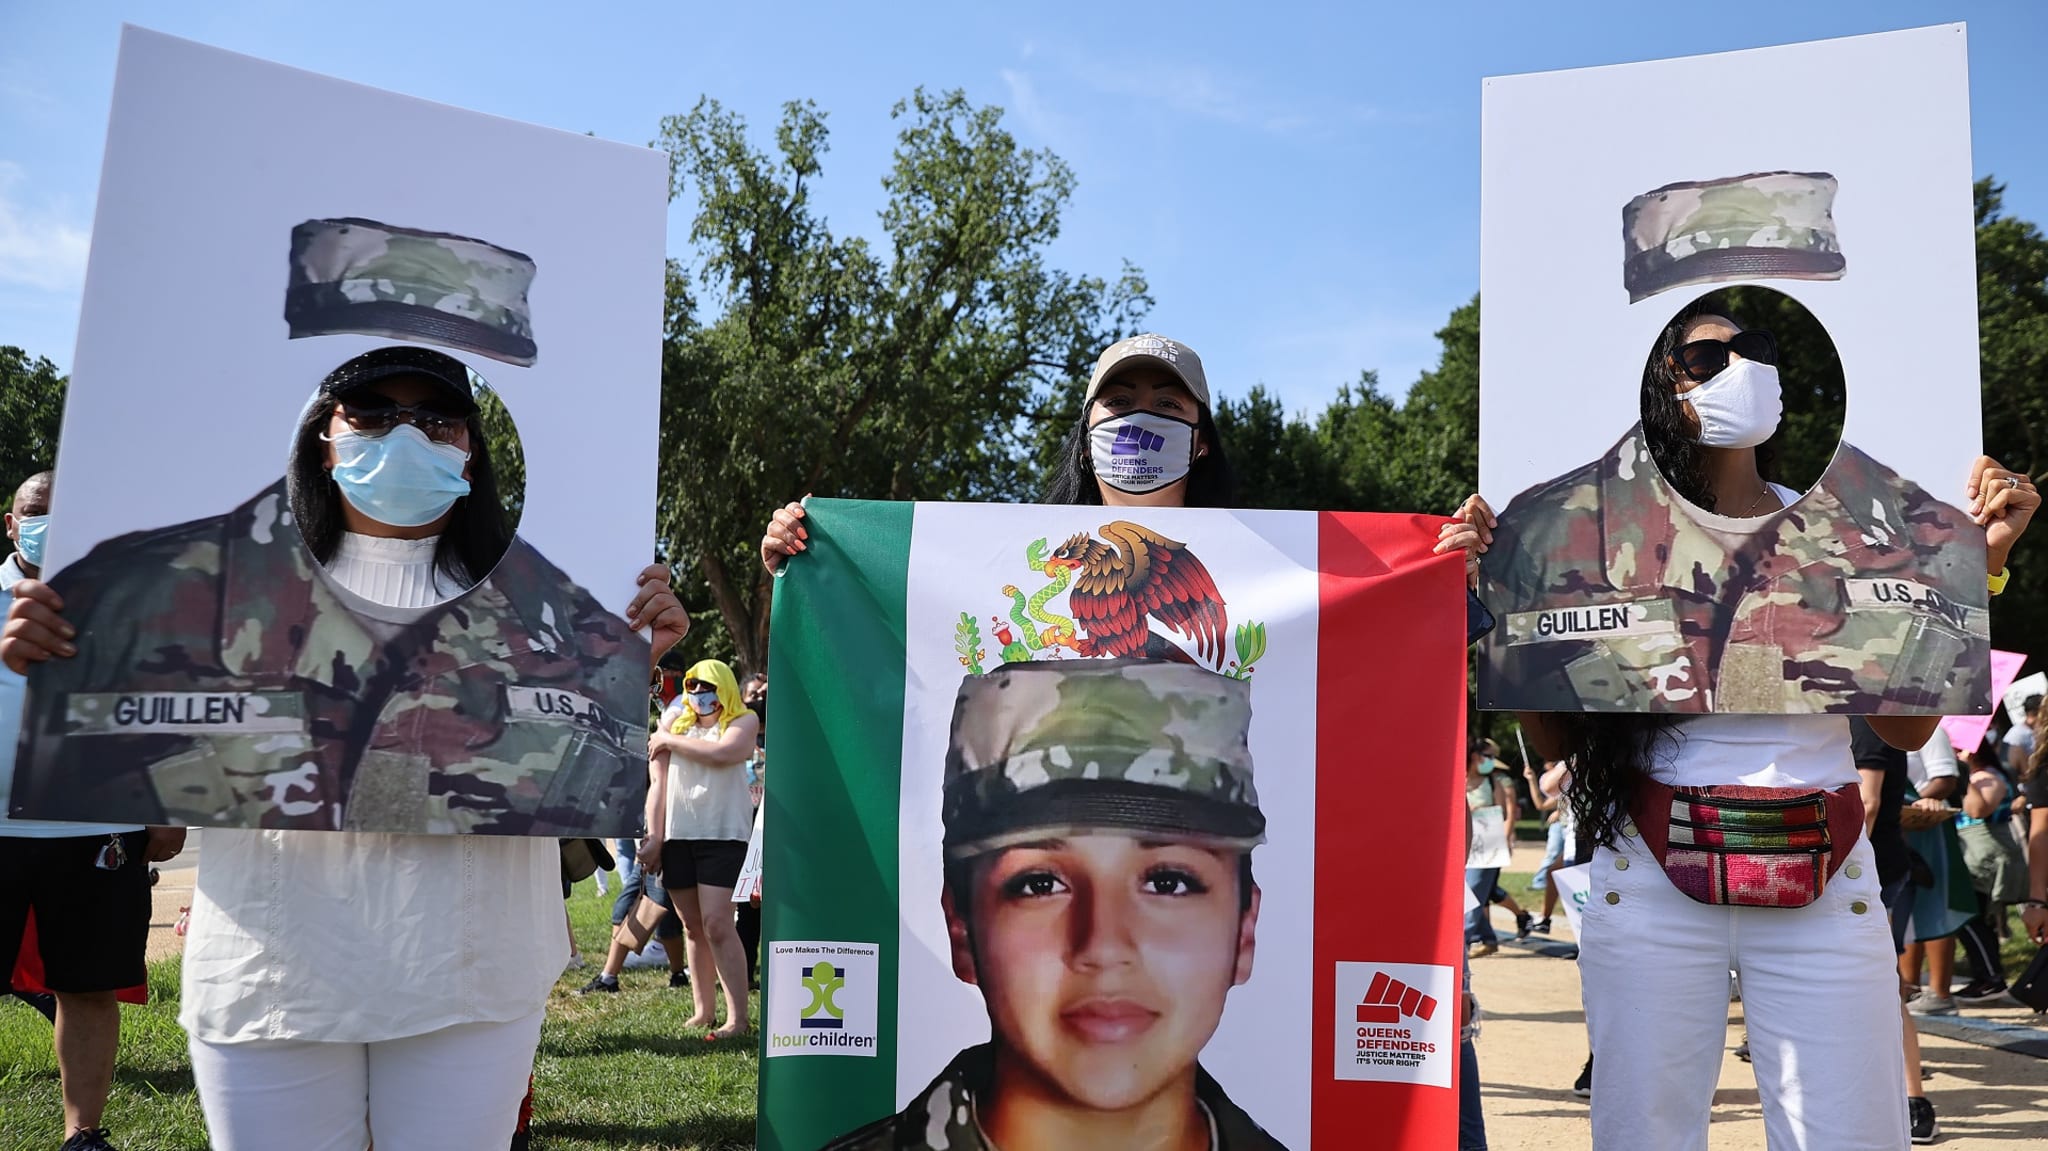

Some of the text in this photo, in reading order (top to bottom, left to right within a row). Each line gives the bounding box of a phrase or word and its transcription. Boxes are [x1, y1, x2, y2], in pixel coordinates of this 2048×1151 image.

[1112, 458, 1148, 466] QUEENS
[1112, 466, 1164, 474] DEFENDERS
[1536, 605, 1631, 637] GUILLEN
[113, 695, 246, 726] GUILLEN
[795, 946, 820, 954] Makes
[821, 946, 836, 954] The
[837, 947, 874, 956] Difference
[1356, 1027, 1411, 1039] QUEENS
[772, 1031, 873, 1048] hourchildren
[1356, 1039, 1436, 1053] DEFENDERS
[1389, 1052, 1426, 1060] MATTERS
[1373, 1058, 1395, 1066] YOUR
[1395, 1059, 1421, 1068] RIGHT
